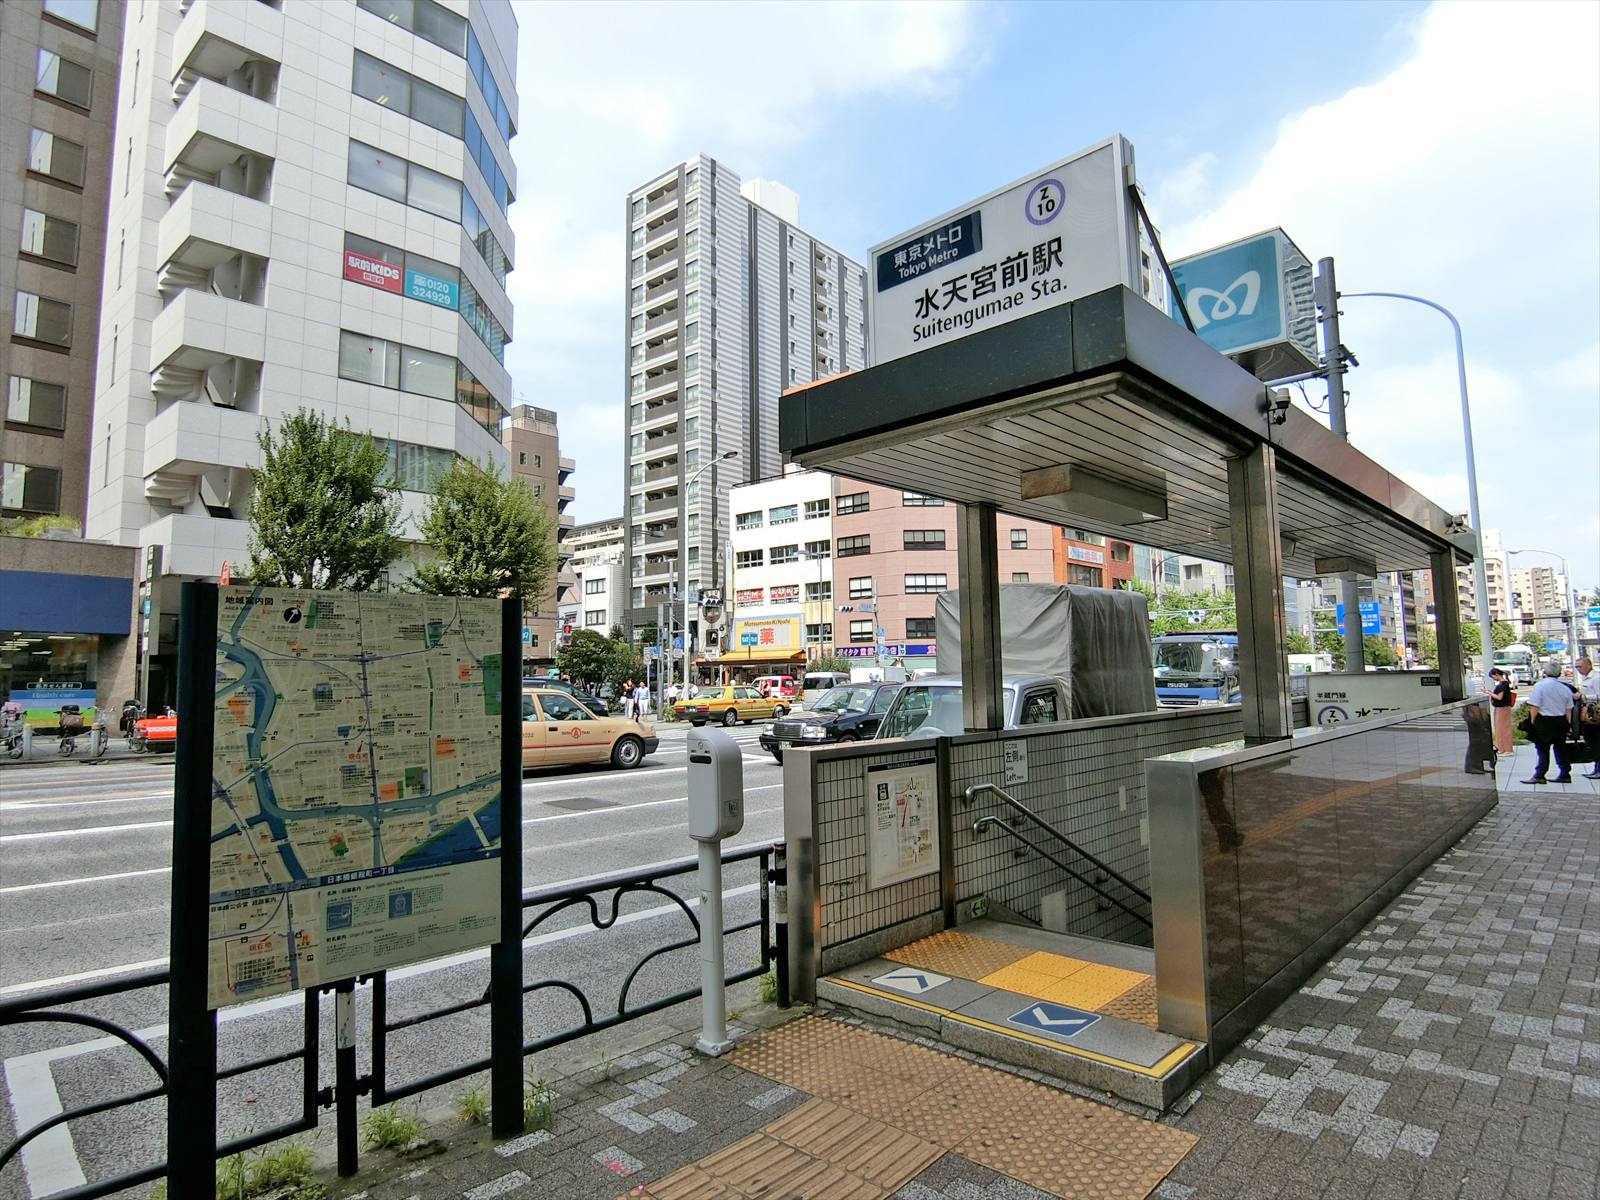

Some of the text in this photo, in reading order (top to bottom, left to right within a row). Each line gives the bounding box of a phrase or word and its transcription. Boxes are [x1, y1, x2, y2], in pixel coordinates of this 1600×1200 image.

[1040, 186, 1049, 201] Z
[1037, 199, 1055, 217] 10
[894, 225, 962, 268] 東京メトロ
[348, 255, 400, 280] 駅前KIDS
[898, 247, 959, 279] Tokyo Metro
[427, 279, 450, 294] 0120
[914, 236, 1064, 320] 水天宮前駅
[412, 285, 451, 304] 324929
[913, 277, 1068, 342] Suitengumae Sta.
[225, 596, 274, 606] 地域案内図
[760, 627, 775, 645] 薬
[1329, 710, 1336, 718] Z
[1006, 772, 1017, 782] Left
[210, 901, 249, 913] 日本橋公会堂
[249, 941, 273, 951] 現在地
